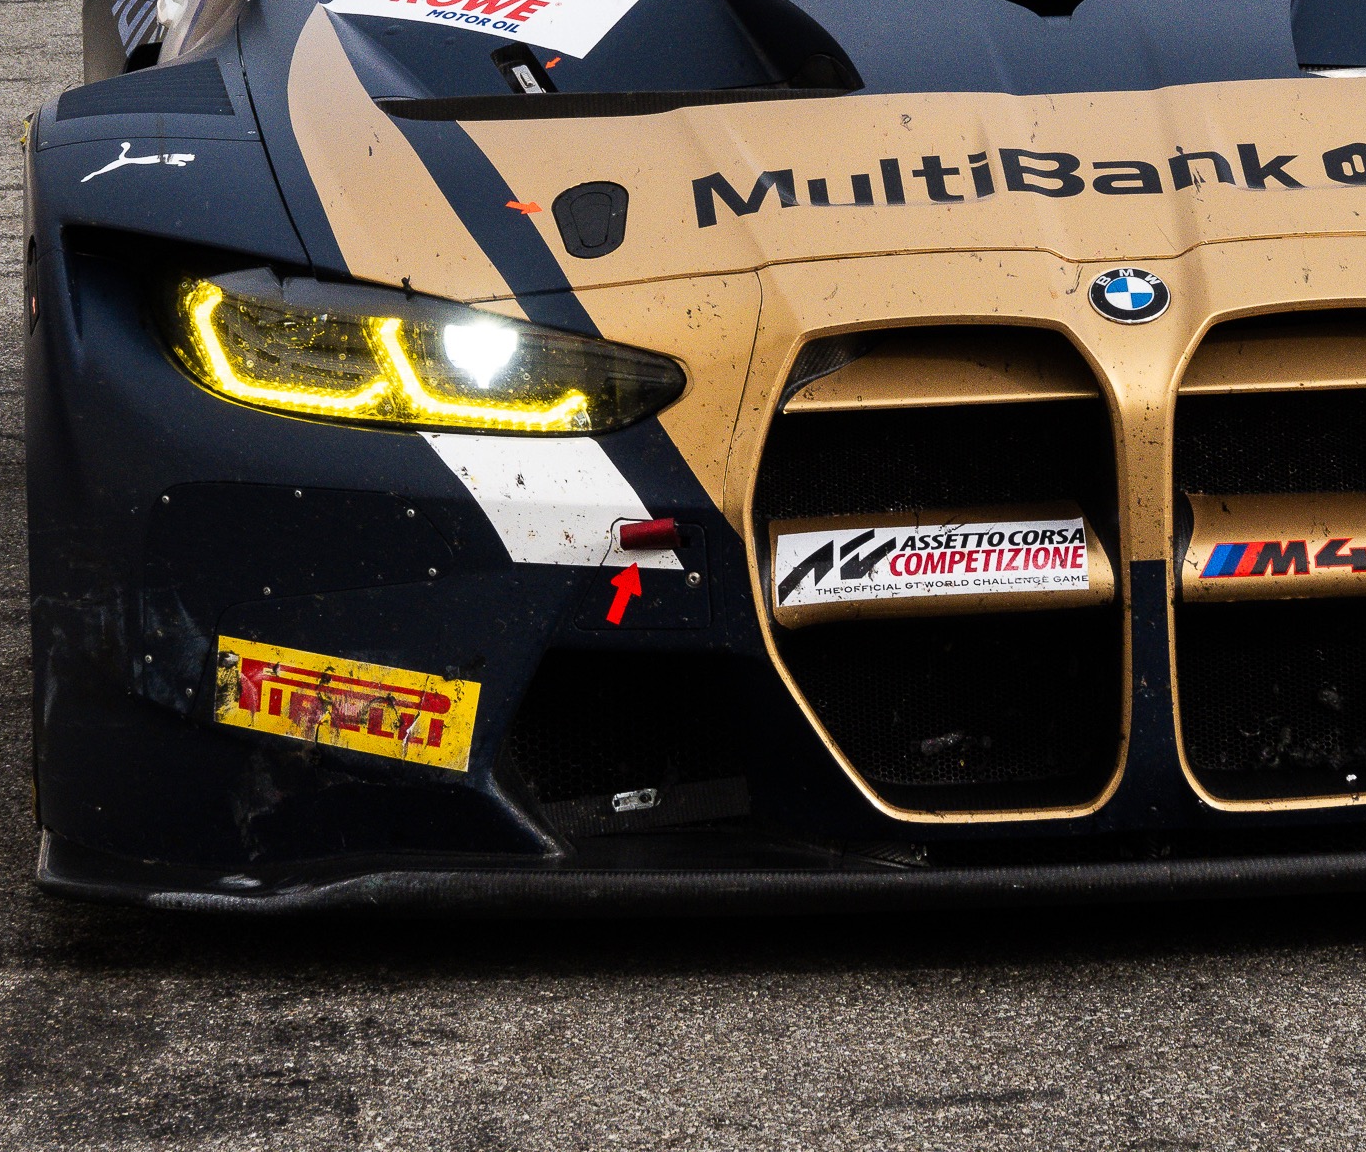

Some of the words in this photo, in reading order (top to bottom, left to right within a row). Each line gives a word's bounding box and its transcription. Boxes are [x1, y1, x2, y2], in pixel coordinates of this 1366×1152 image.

[426, 9, 492, 27] MOTOR
[492, 21, 522, 34] OIL
[691, 142, 1308, 229] MultiBank
[1095, 268, 1162, 287] BMW
[900, 531, 1007, 552] ASSETTO
[1008, 527, 1085, 547] CORSA
[889, 544, 1085, 577] COMPETIZIONE
[815, 586, 841, 597] THE
[843, 583, 902, 594] OFFICIAL
[905, 581, 922, 590] GT
[924, 578, 970, 588] WORLD
[973, 575, 1050, 586] CHALLENGE
[1053, 574, 1090, 583] GAME
